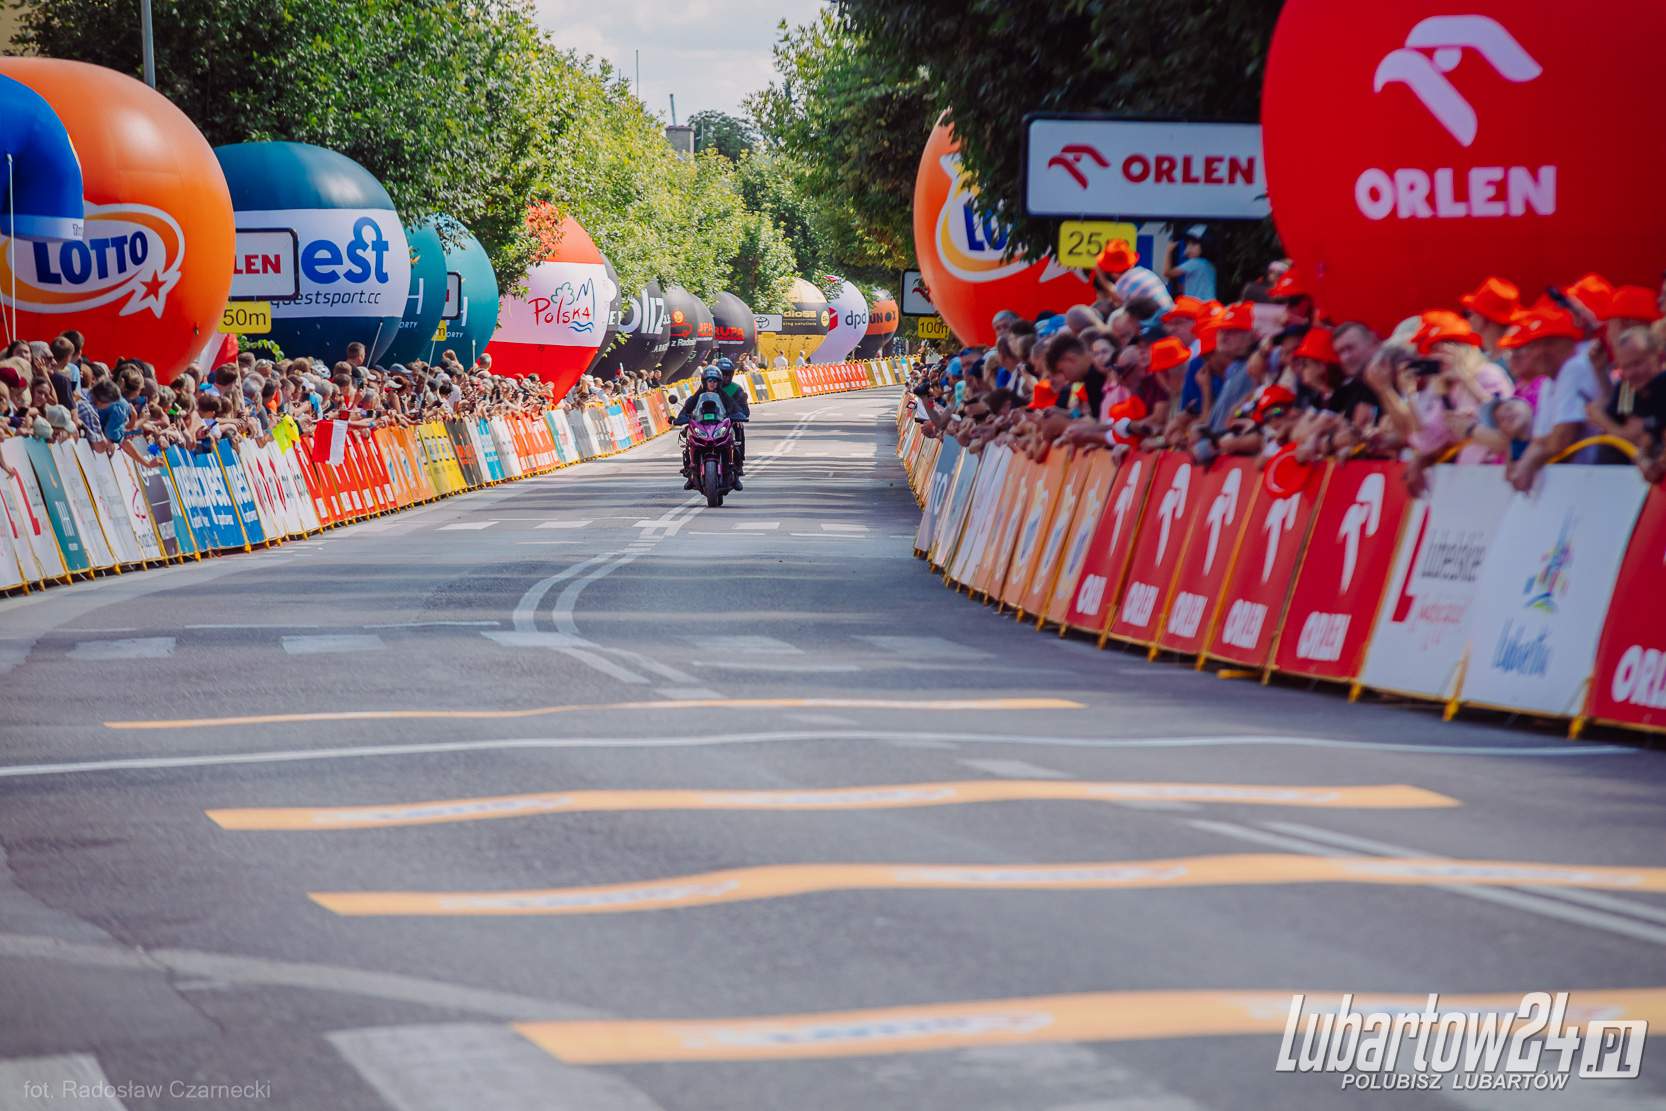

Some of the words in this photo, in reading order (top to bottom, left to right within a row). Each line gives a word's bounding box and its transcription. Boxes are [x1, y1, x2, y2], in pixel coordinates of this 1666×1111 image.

[1121, 153, 1256, 185] ORLEN
[1354, 165, 1558, 221] ORLEN
[32, 230, 149, 285] LOTTO
[233, 253, 282, 275] LEN
[300, 216, 390, 285] est
[223, 308, 266, 326] 50m
[400, 321, 418, 329] ORTY
[1611, 645, 1666, 710] ORL
